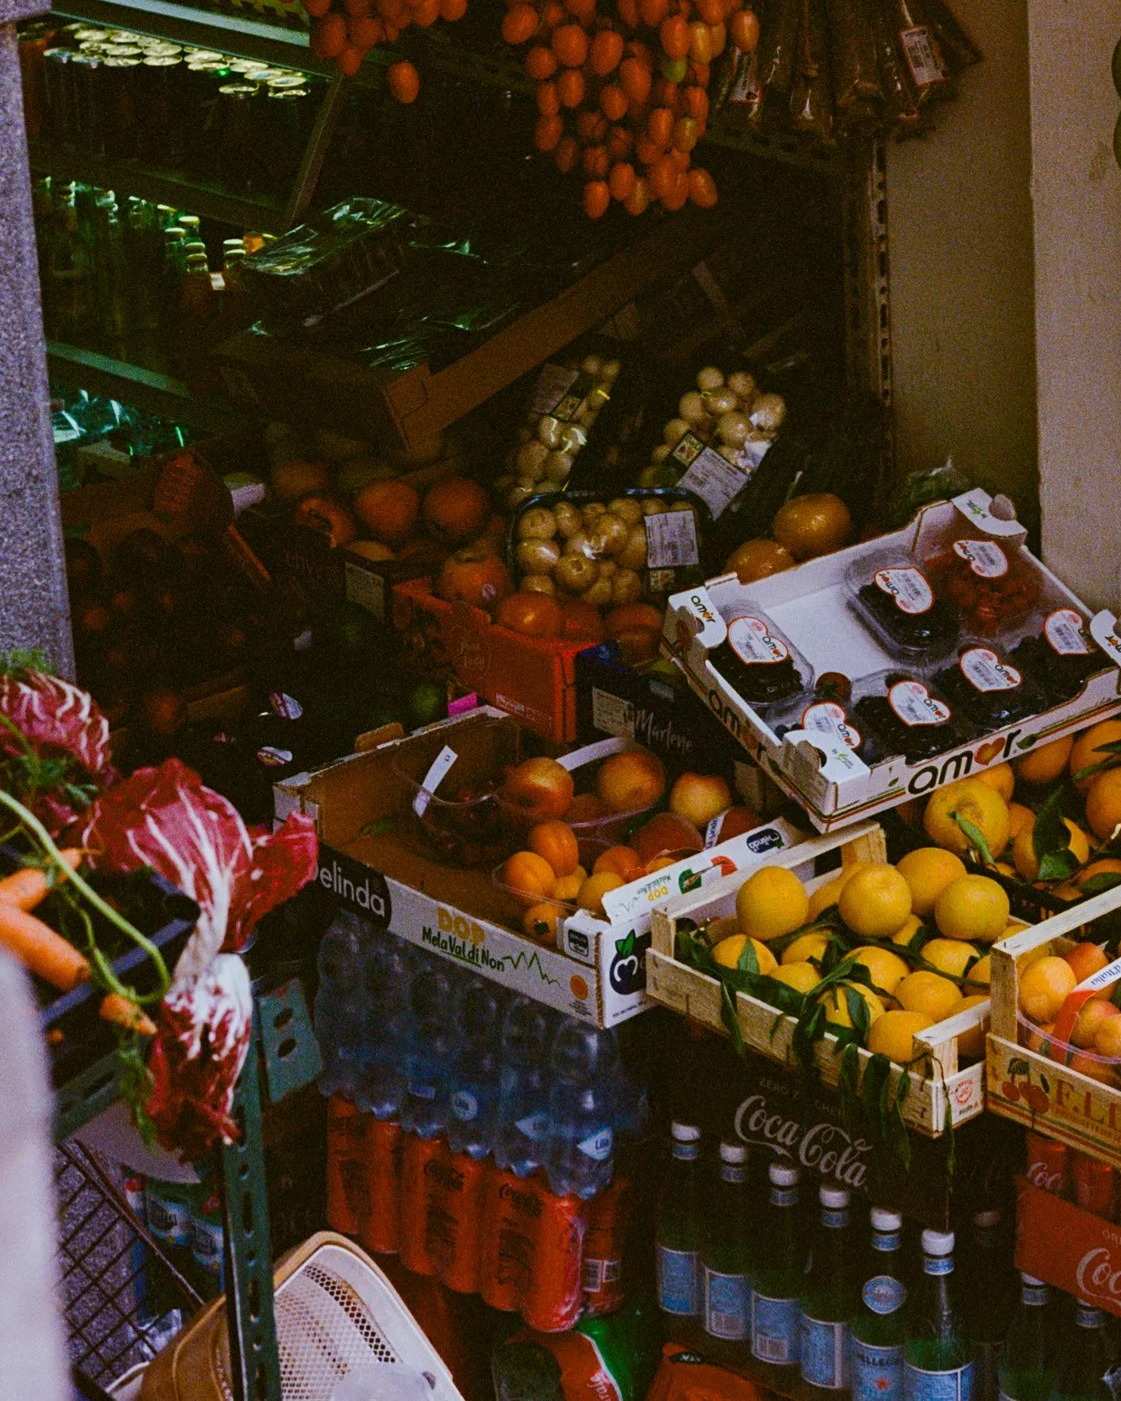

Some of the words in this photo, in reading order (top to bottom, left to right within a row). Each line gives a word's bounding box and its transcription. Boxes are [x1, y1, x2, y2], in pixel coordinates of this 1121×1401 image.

[313, 863, 386, 918] elinda
[437, 906, 486, 946] DOP
[734, 1095, 874, 1188] Coca-Cola
